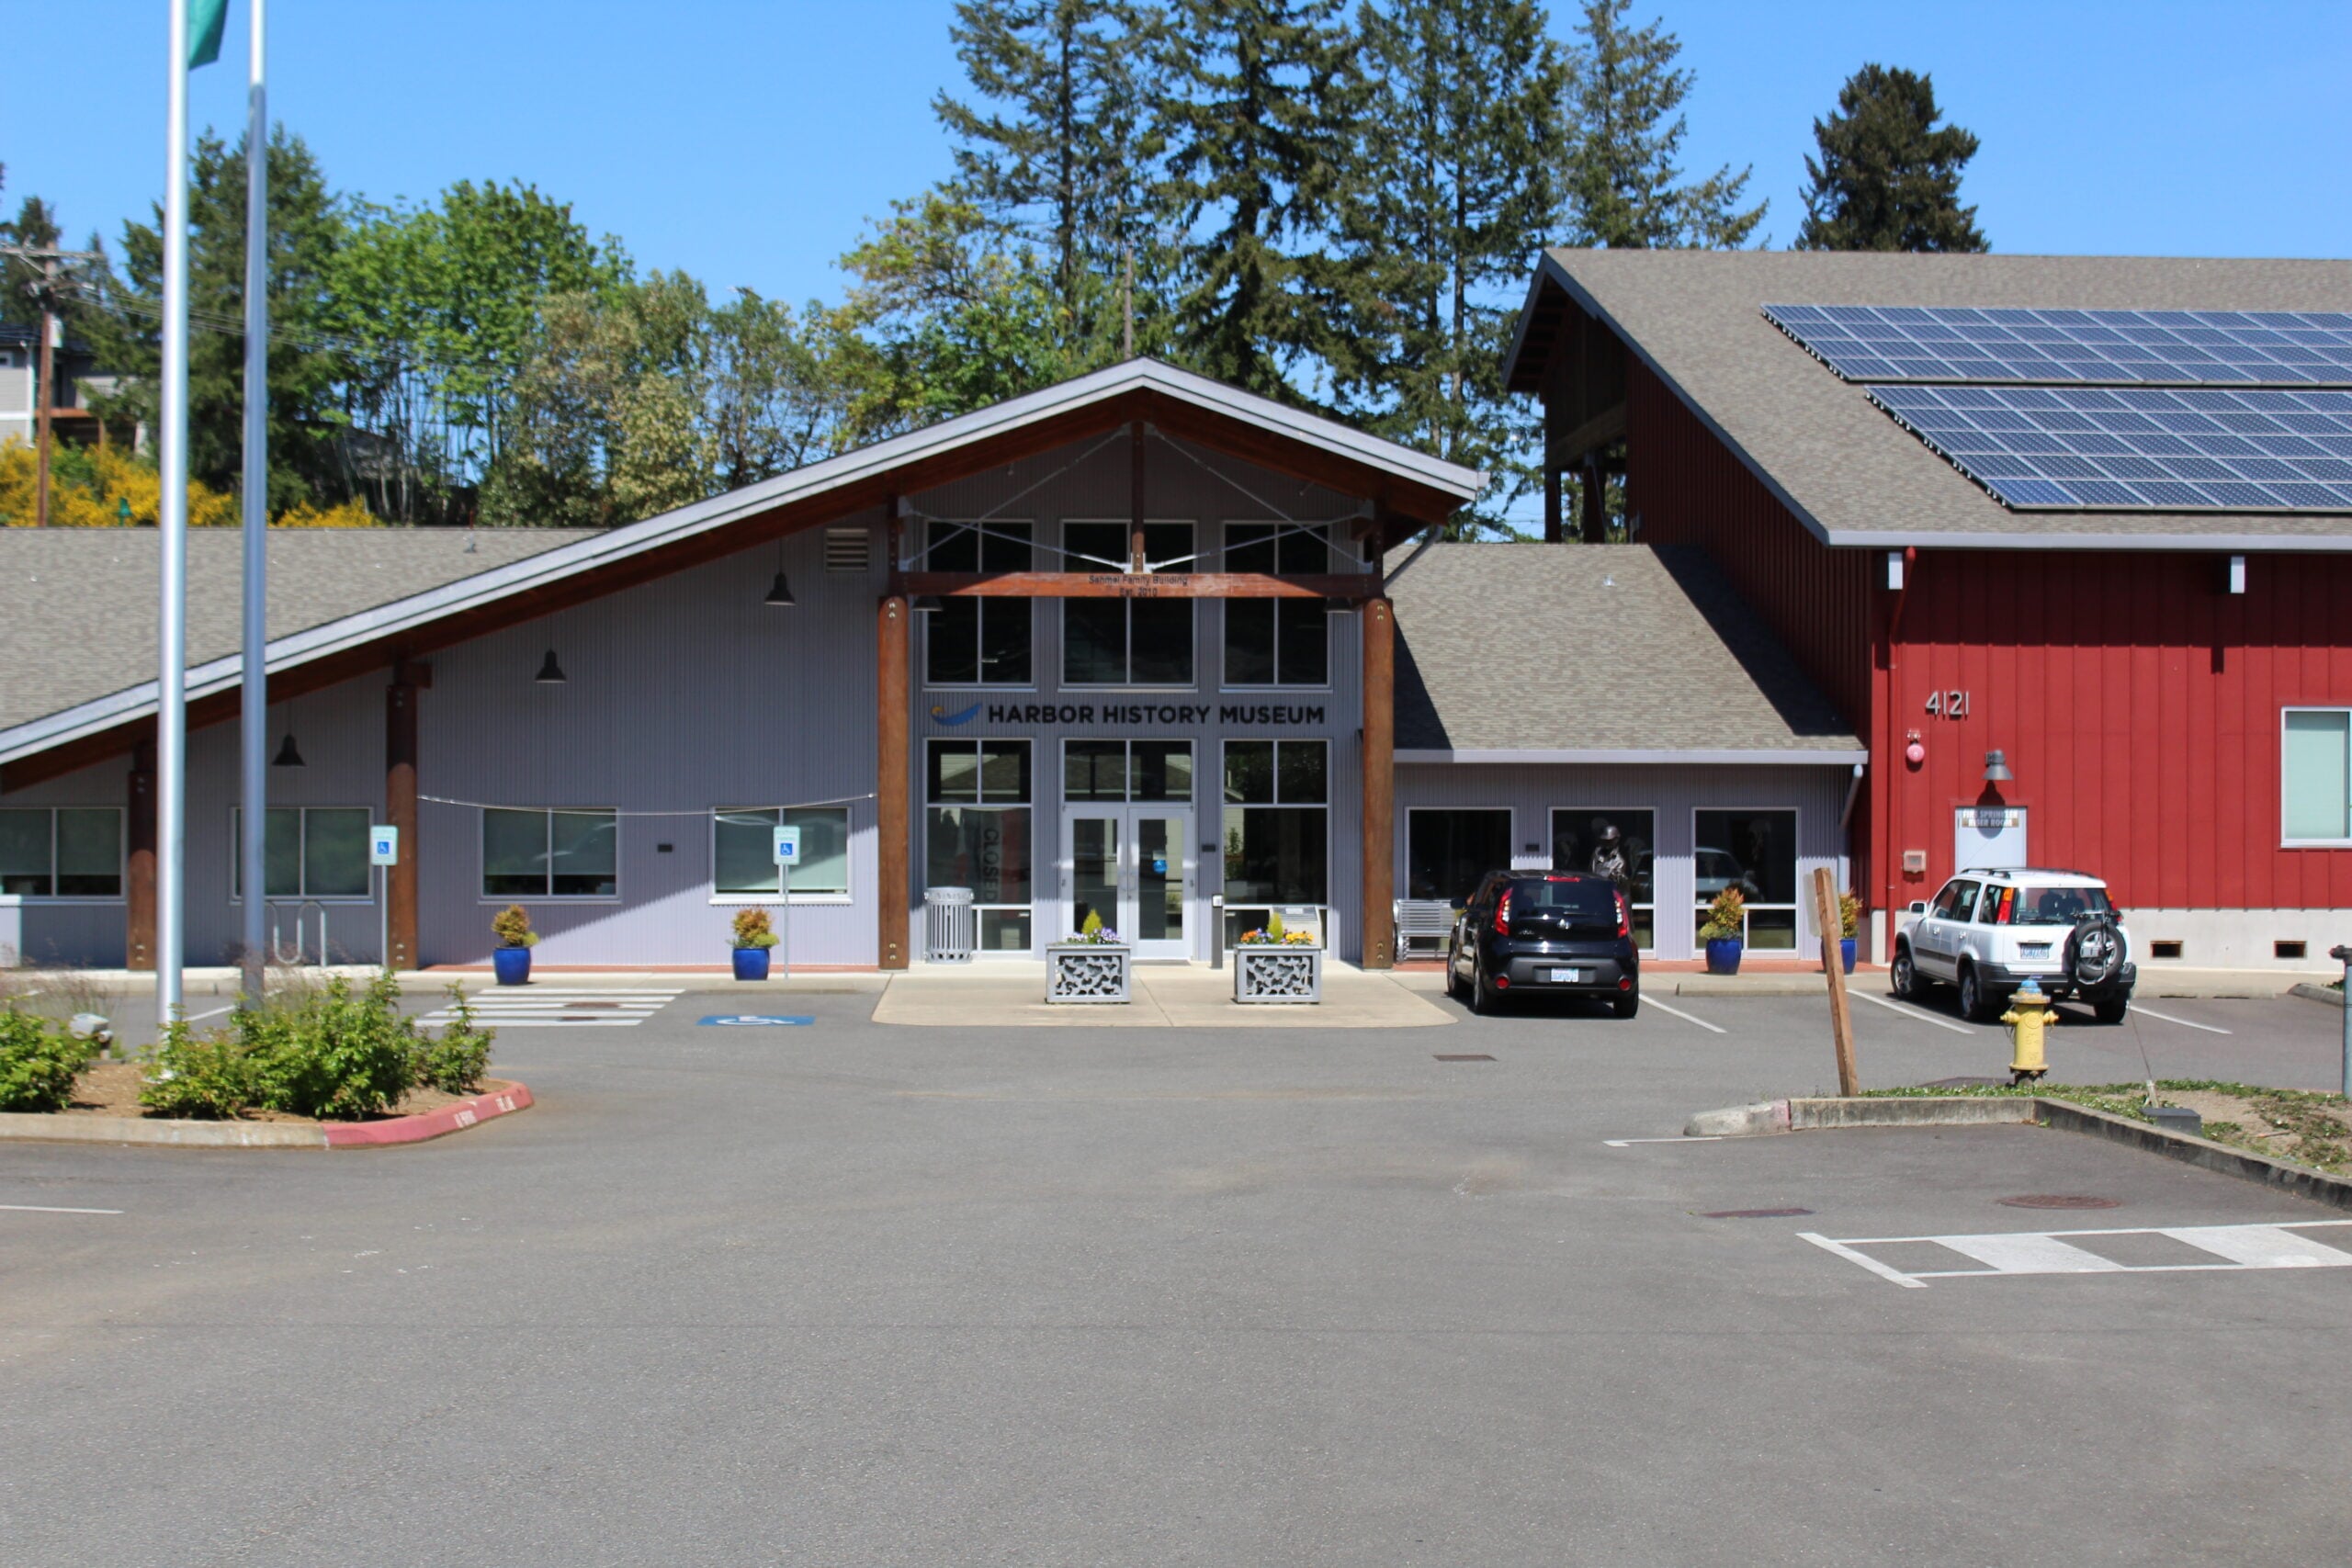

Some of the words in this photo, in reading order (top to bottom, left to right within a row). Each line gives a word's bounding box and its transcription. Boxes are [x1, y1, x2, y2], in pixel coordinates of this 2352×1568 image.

[1123, 575, 1150, 586] Family
[1153, 575, 1188, 586] Building
[1138, 587, 1158, 597] 2010
[1925, 690, 1970, 716] 4121
[989, 705, 1094, 725] HARBOR
[1102, 705, 1211, 725] HISTORY
[1219, 705, 1325, 725] MUSEUM
[983, 828, 1000, 901] CLOSED
